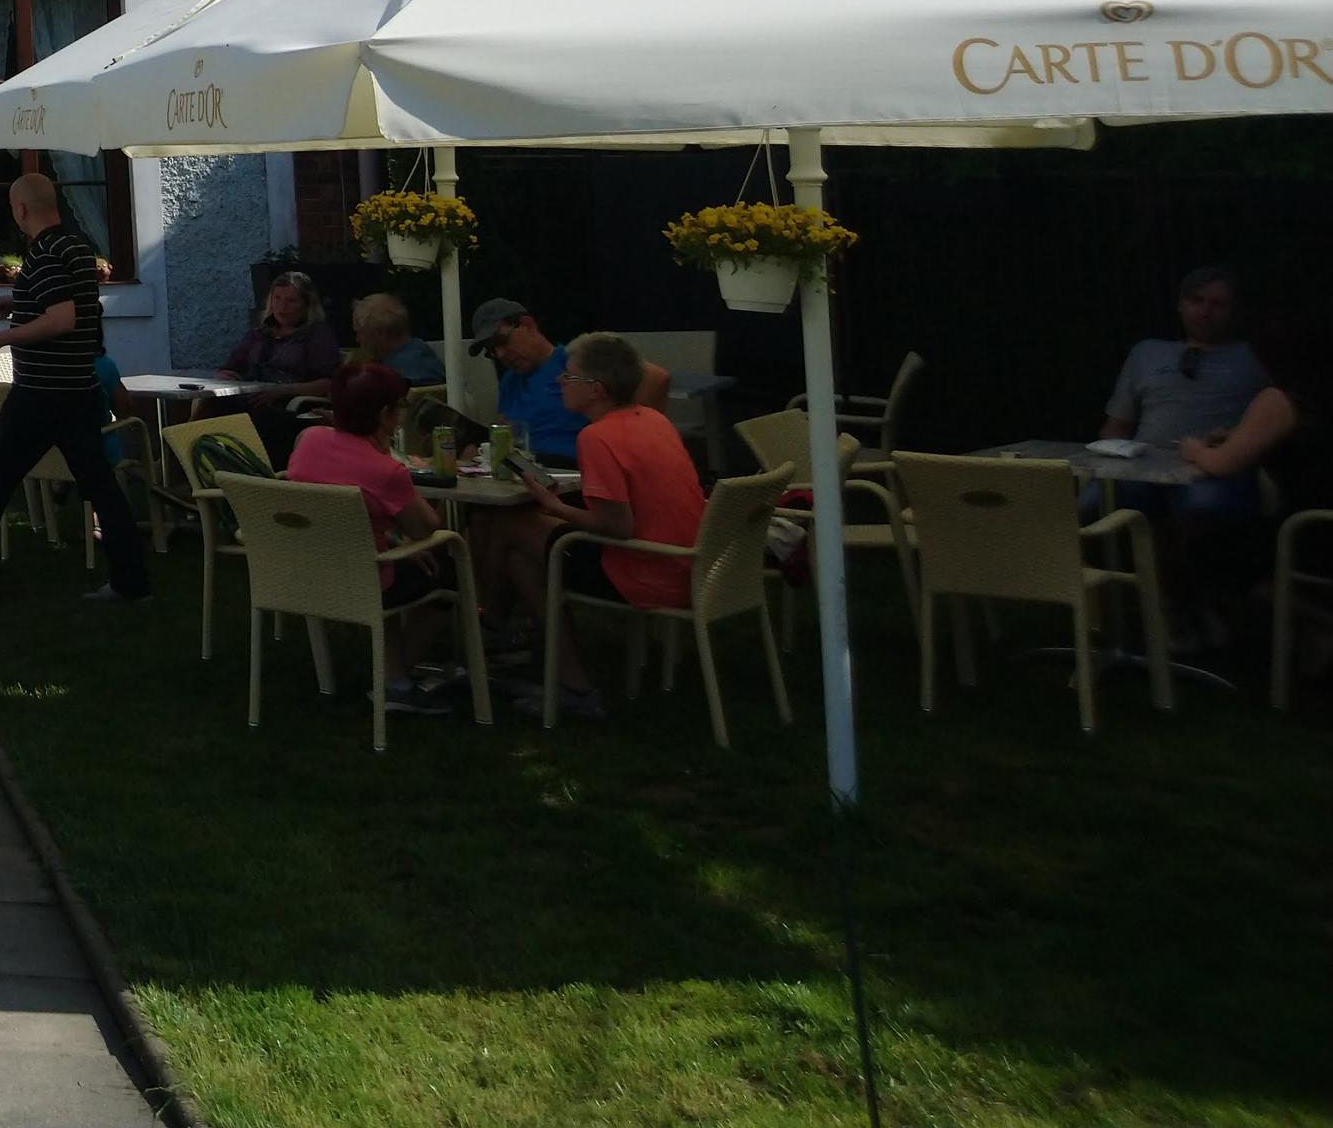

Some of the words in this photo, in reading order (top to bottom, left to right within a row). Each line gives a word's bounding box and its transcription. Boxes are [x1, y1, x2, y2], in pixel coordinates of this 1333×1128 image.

[953, 36, 1149, 95] CARTE
[12, 104, 31, 135] CARTE
[166, 89, 195, 130] CARTE
